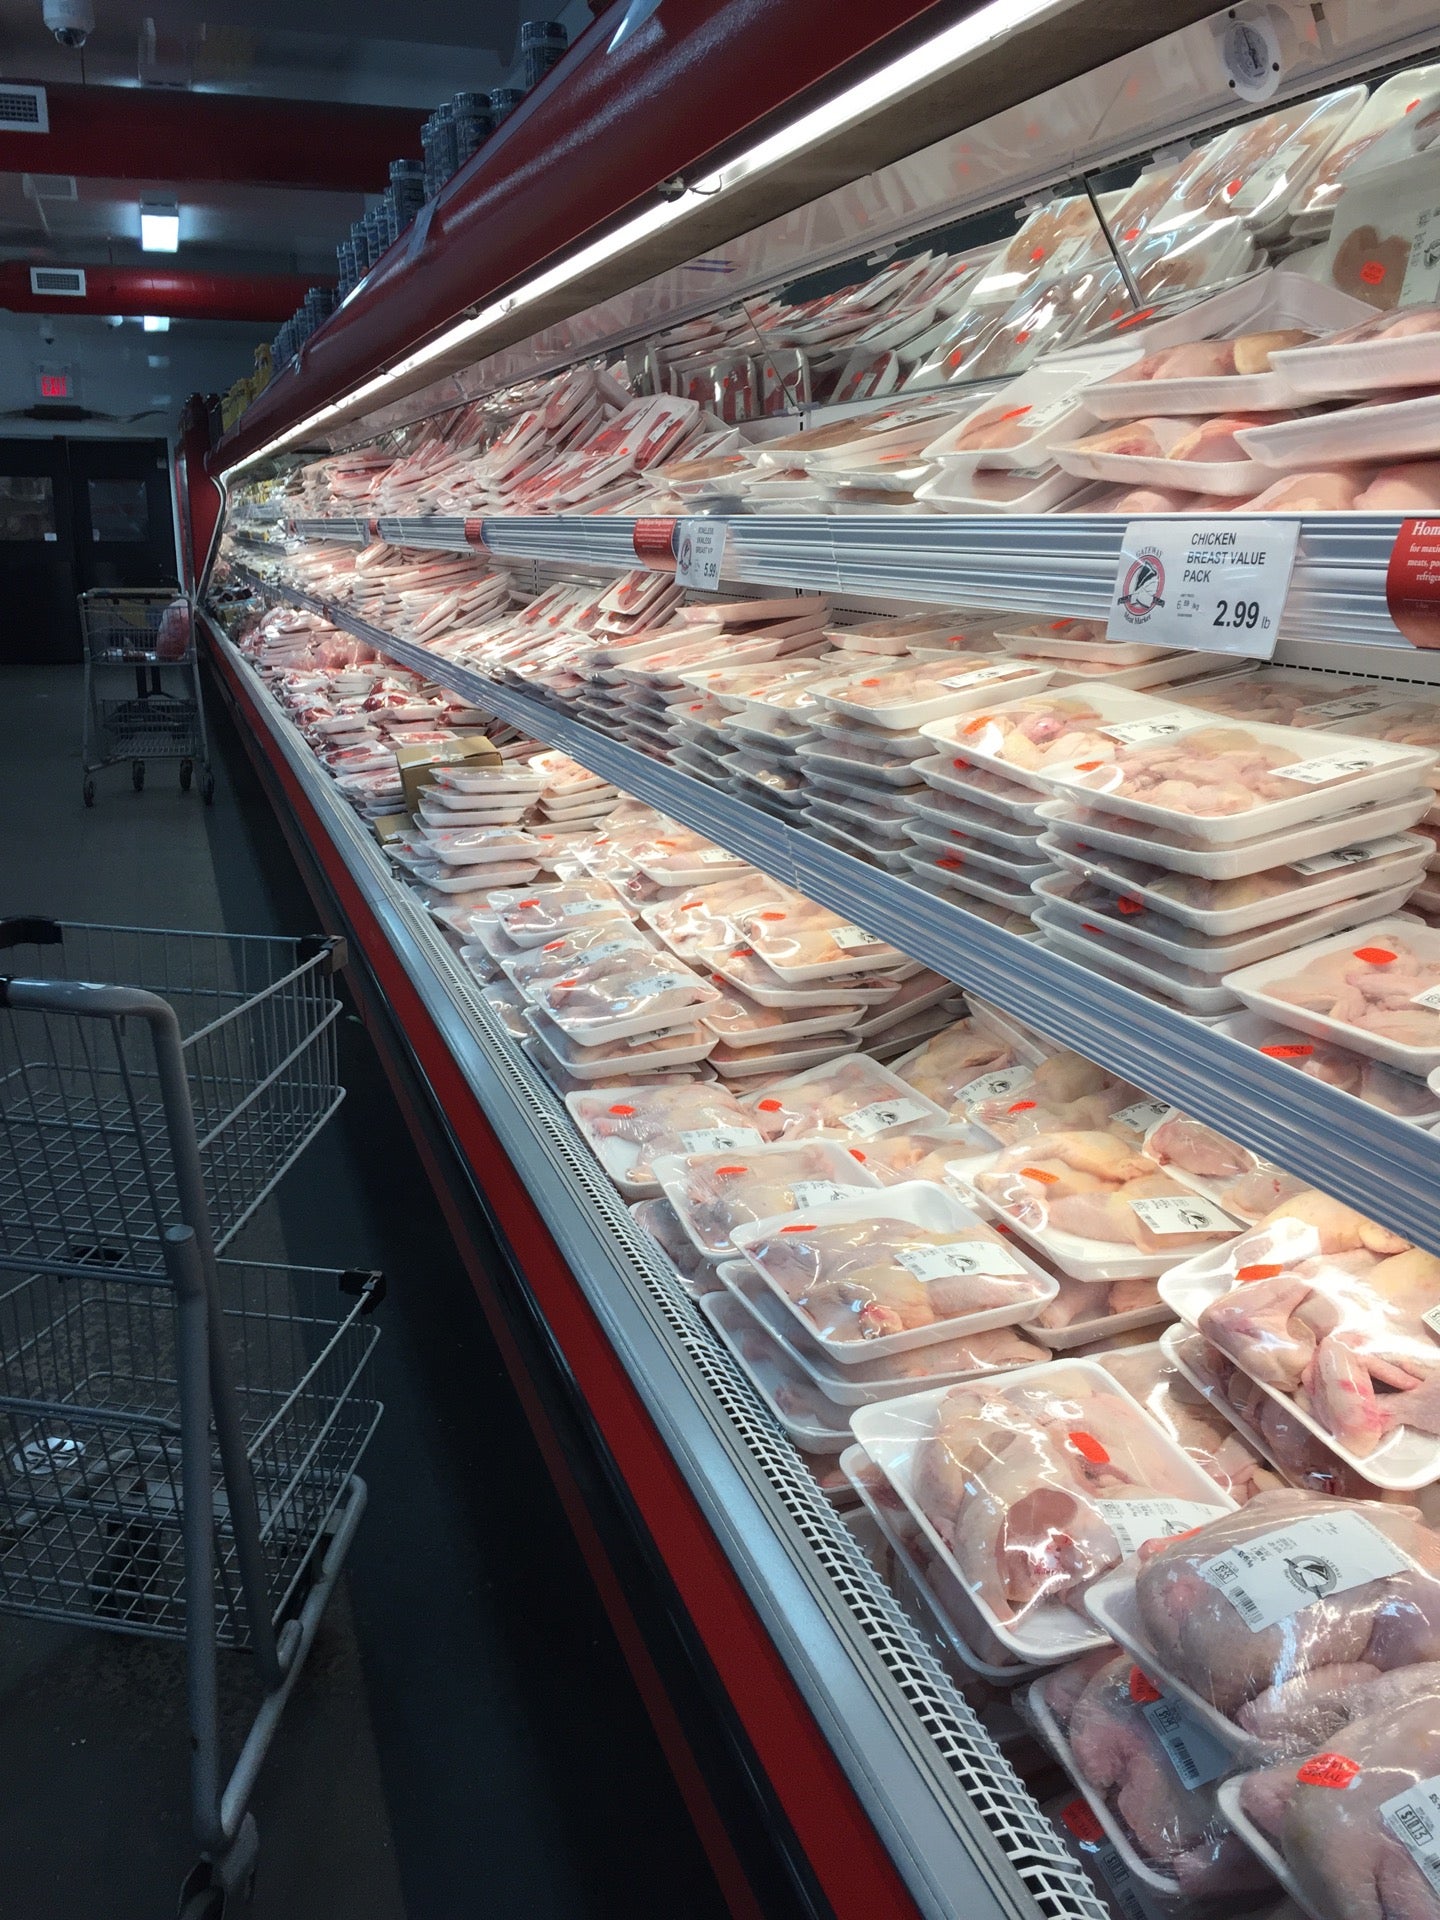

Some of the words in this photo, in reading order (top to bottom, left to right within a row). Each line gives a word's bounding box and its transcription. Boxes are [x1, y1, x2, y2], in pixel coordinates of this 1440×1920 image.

[1191, 532, 1237, 546] CHICKEN
[1186, 551, 1229, 565] BREAST
[1230, 551, 1267, 565] VALUE
[1182, 569, 1212, 583] PACK
[1212, 600, 1260, 629] 2.99
[1261, 616, 1271, 629] lb
